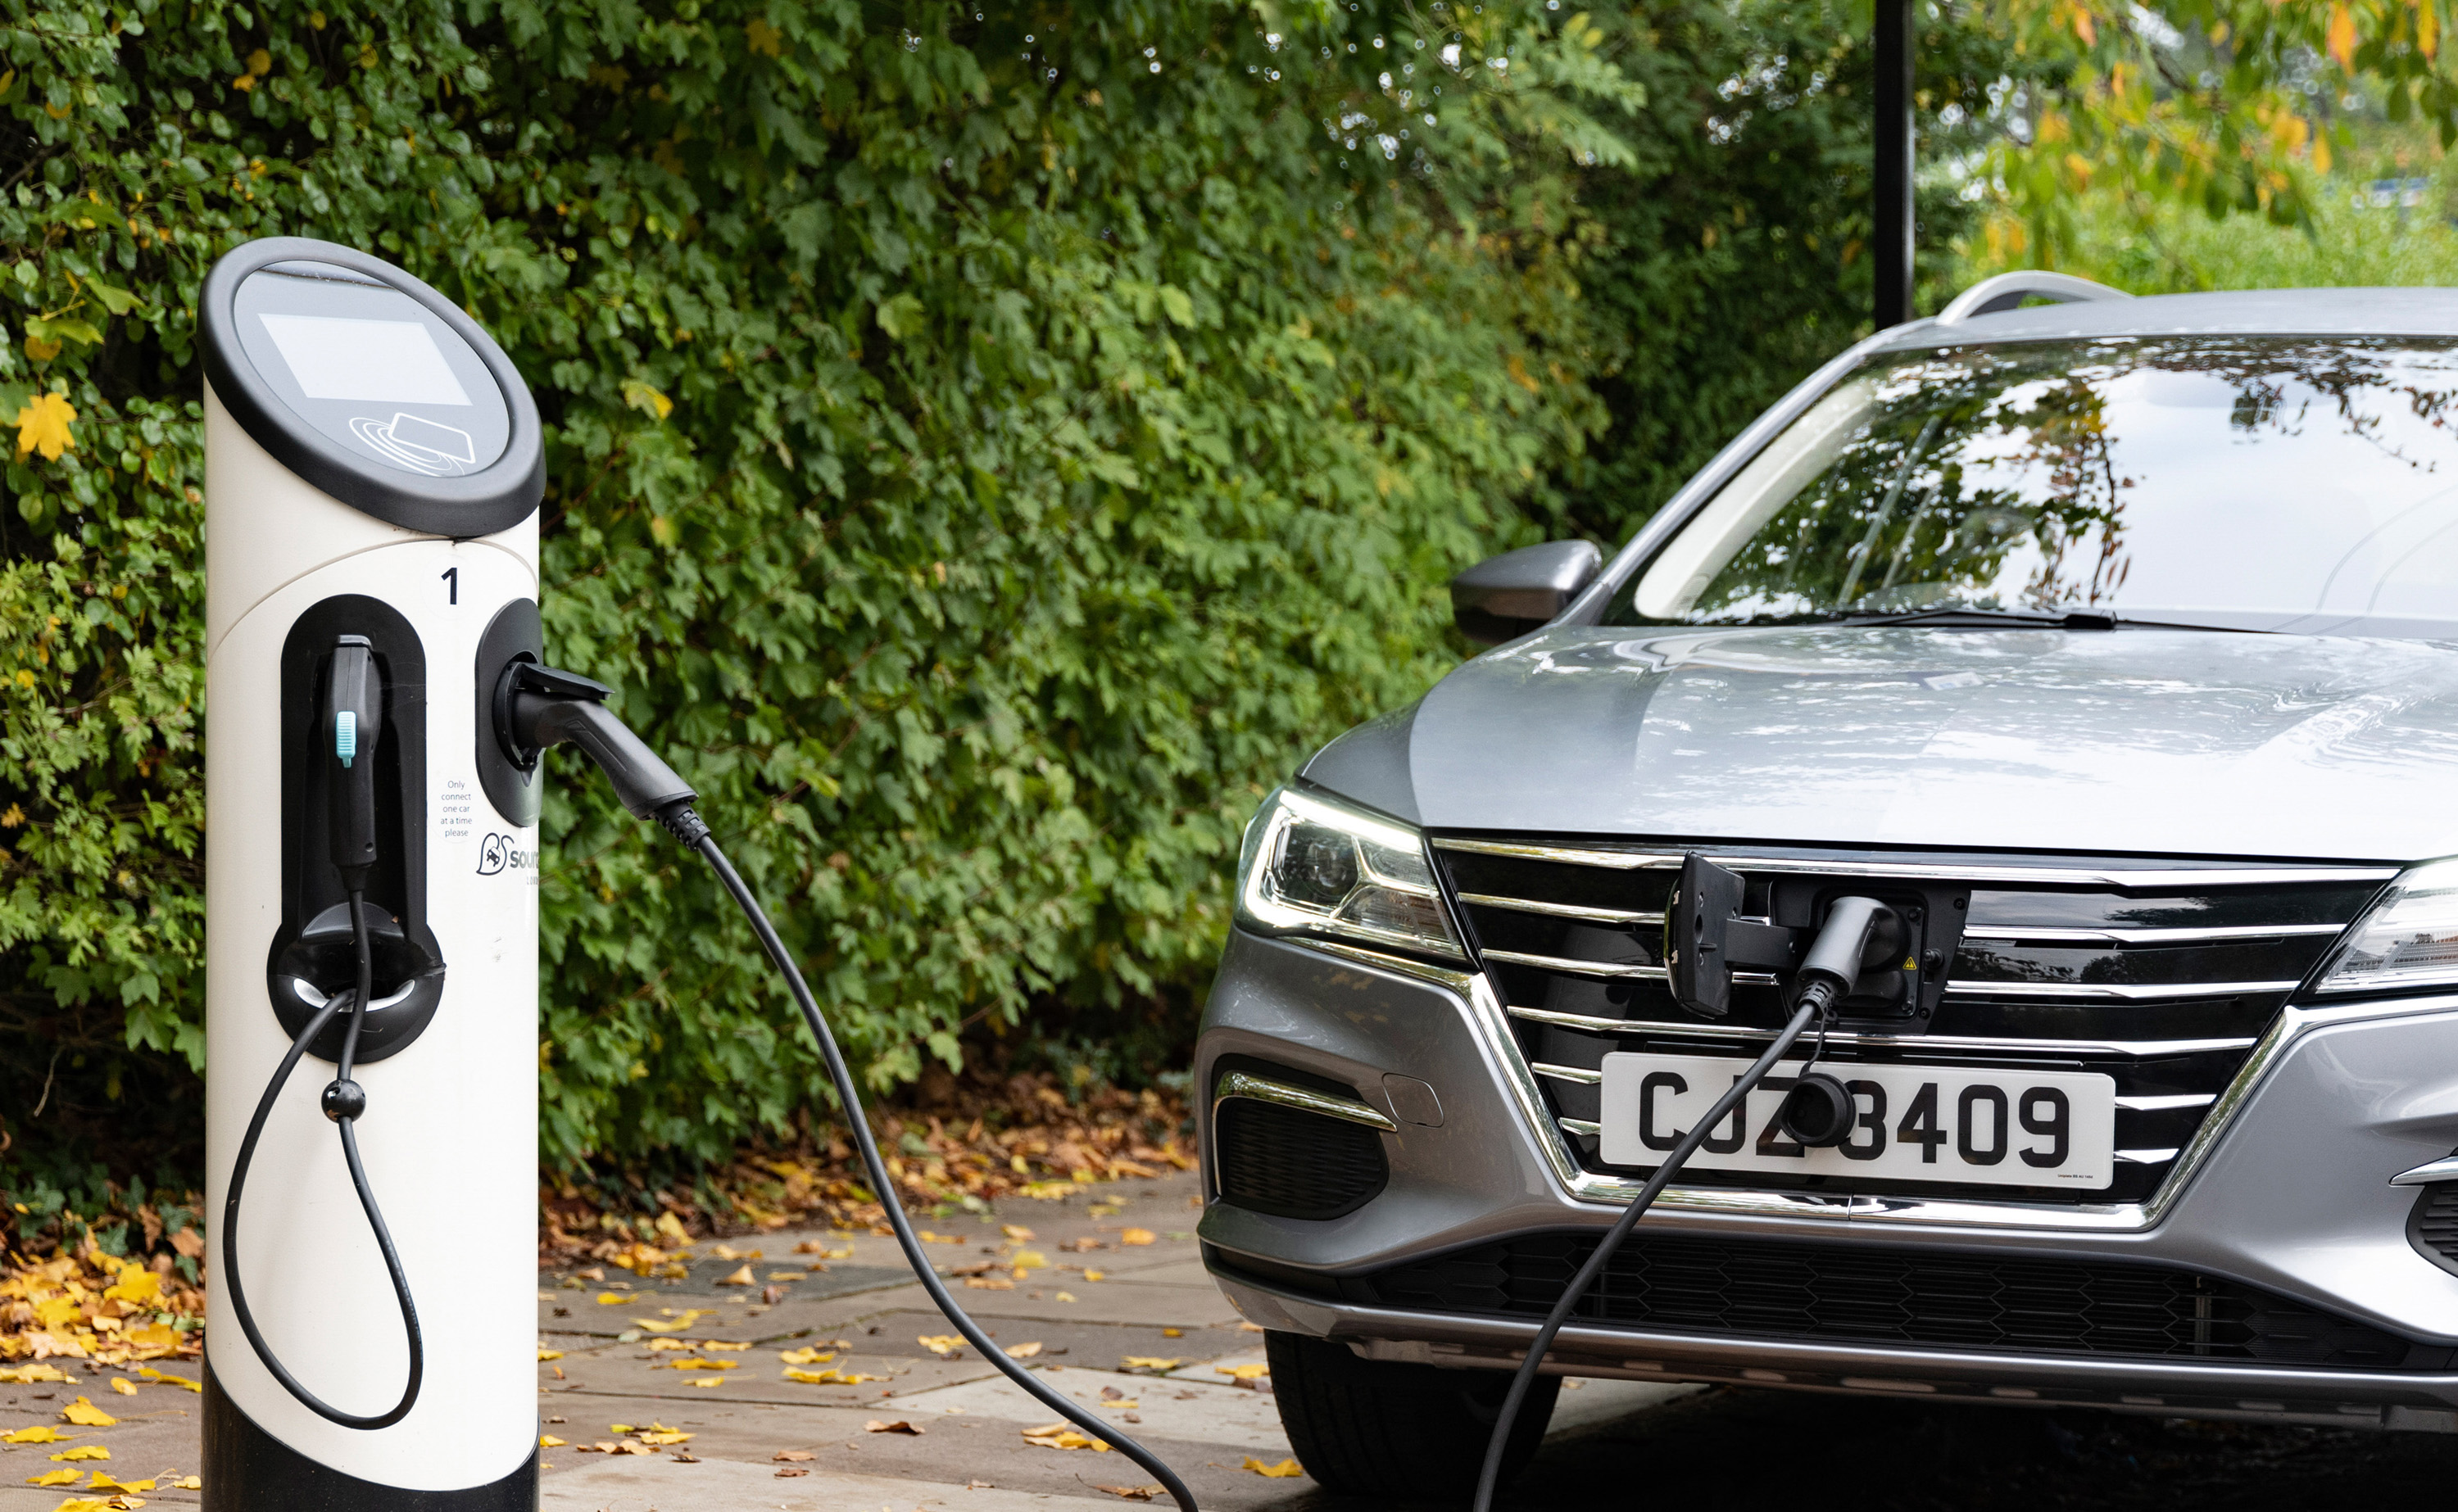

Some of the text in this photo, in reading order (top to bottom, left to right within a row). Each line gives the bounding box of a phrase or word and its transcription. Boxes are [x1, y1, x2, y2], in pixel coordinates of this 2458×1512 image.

[441, 567, 457, 605] 1
[447, 780, 465, 790] Only
[456, 817, 473, 825] time
[445, 828, 469, 838] please
